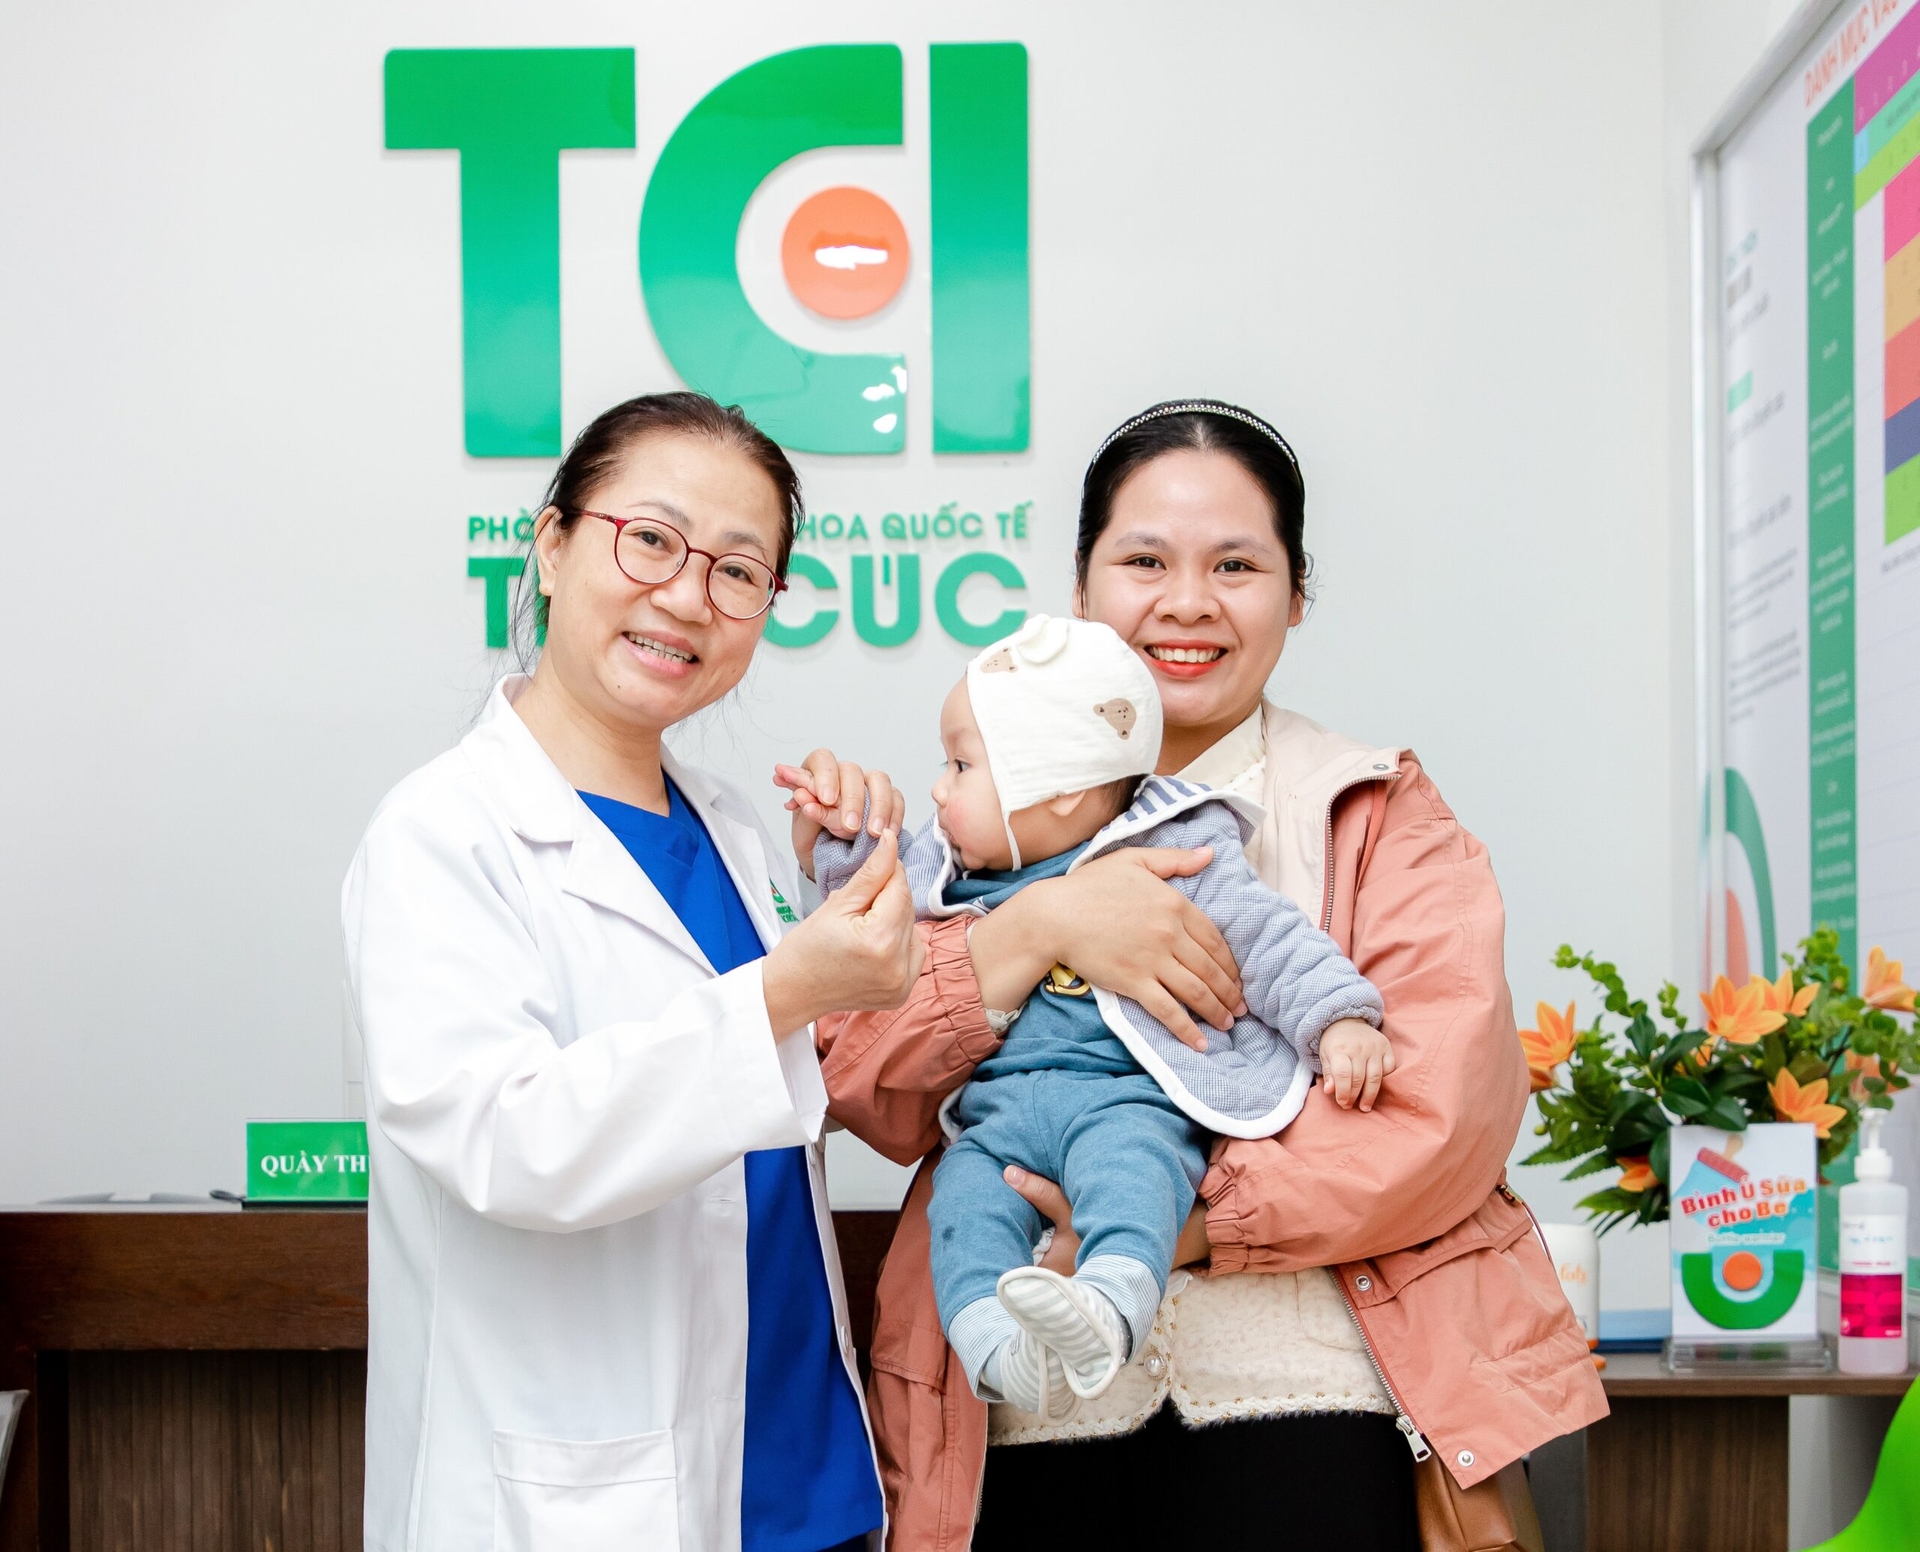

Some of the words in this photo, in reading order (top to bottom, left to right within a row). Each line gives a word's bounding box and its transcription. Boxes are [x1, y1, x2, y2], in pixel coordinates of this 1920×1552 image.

[384, 42, 1030, 458] TCI
[468, 508, 534, 541] PHÒ
[796, 512, 868, 540] HOA
[996, 500, 1033, 539] TẾ
[334, 1154, 371, 1173] TH
[1708, 1208, 1752, 1228] cho
